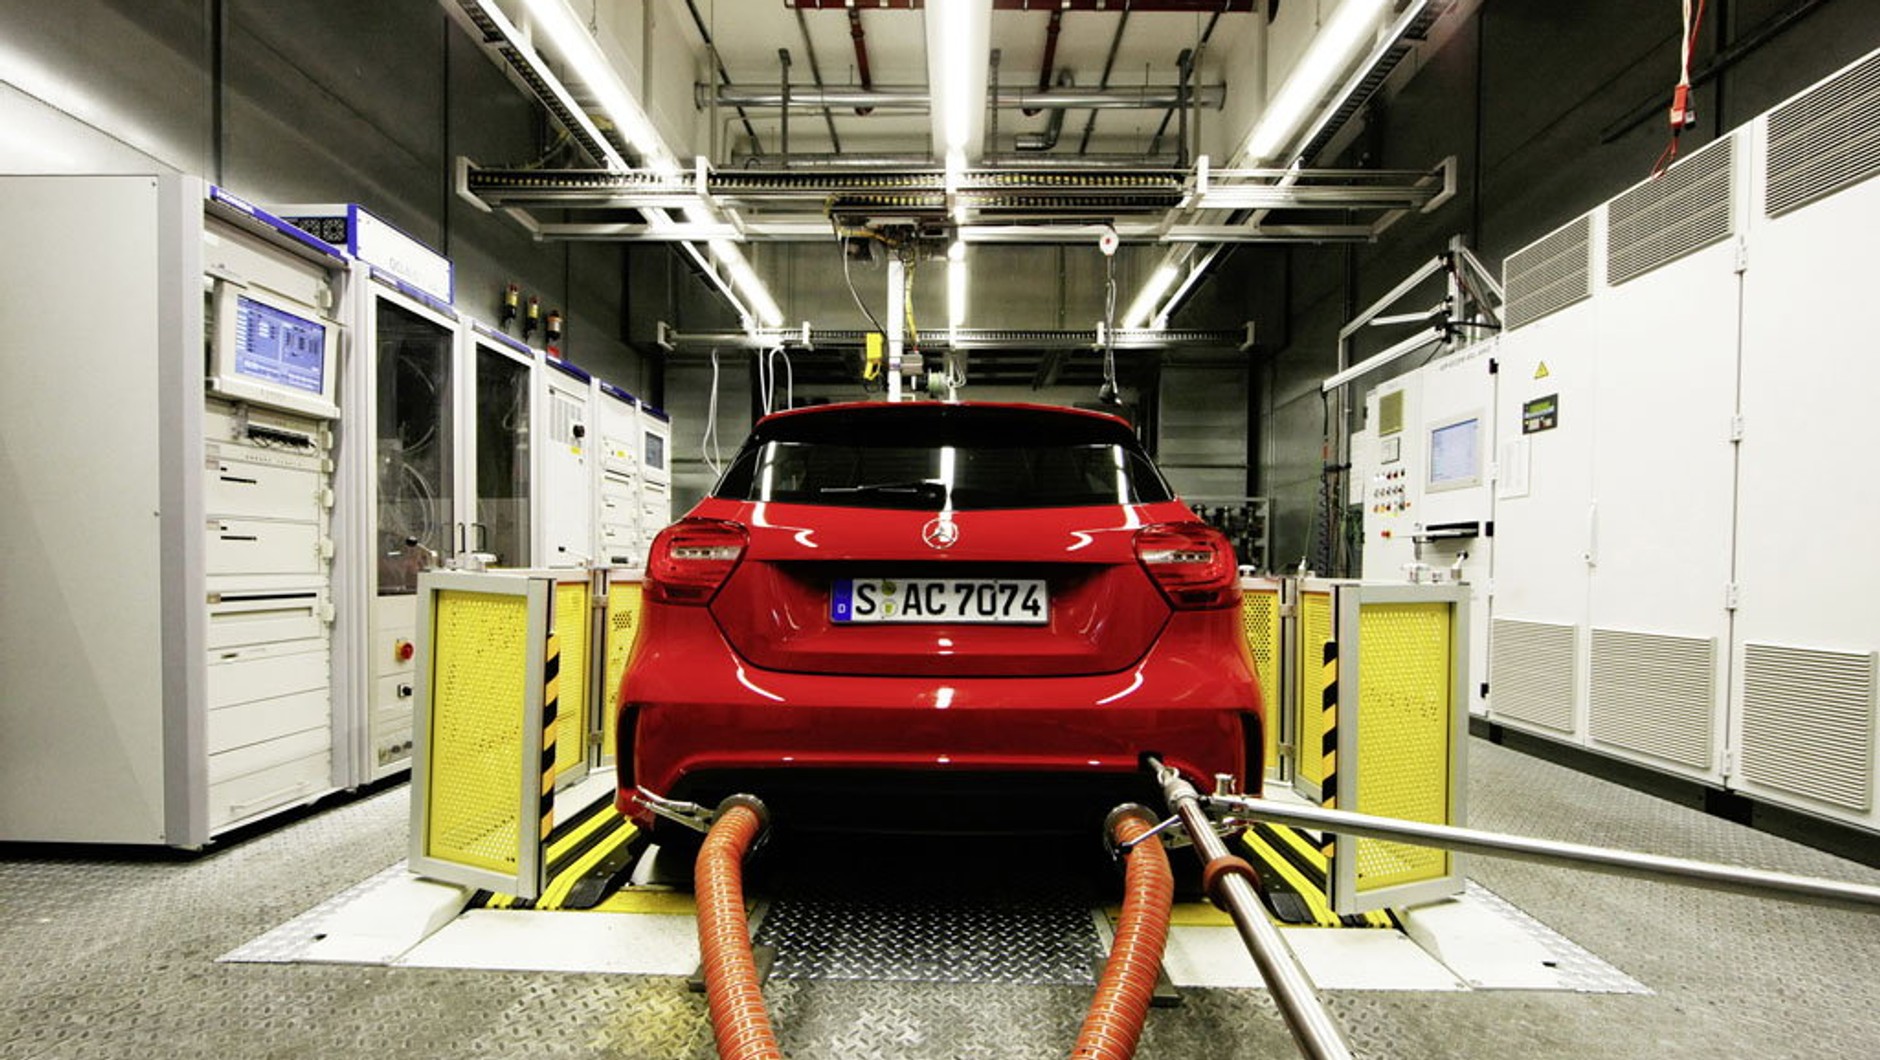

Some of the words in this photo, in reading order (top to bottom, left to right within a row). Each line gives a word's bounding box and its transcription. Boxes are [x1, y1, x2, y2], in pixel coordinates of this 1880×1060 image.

[855, 583, 877, 615] S
[902, 583, 946, 616] AC
[955, 584, 1041, 616] 7074
